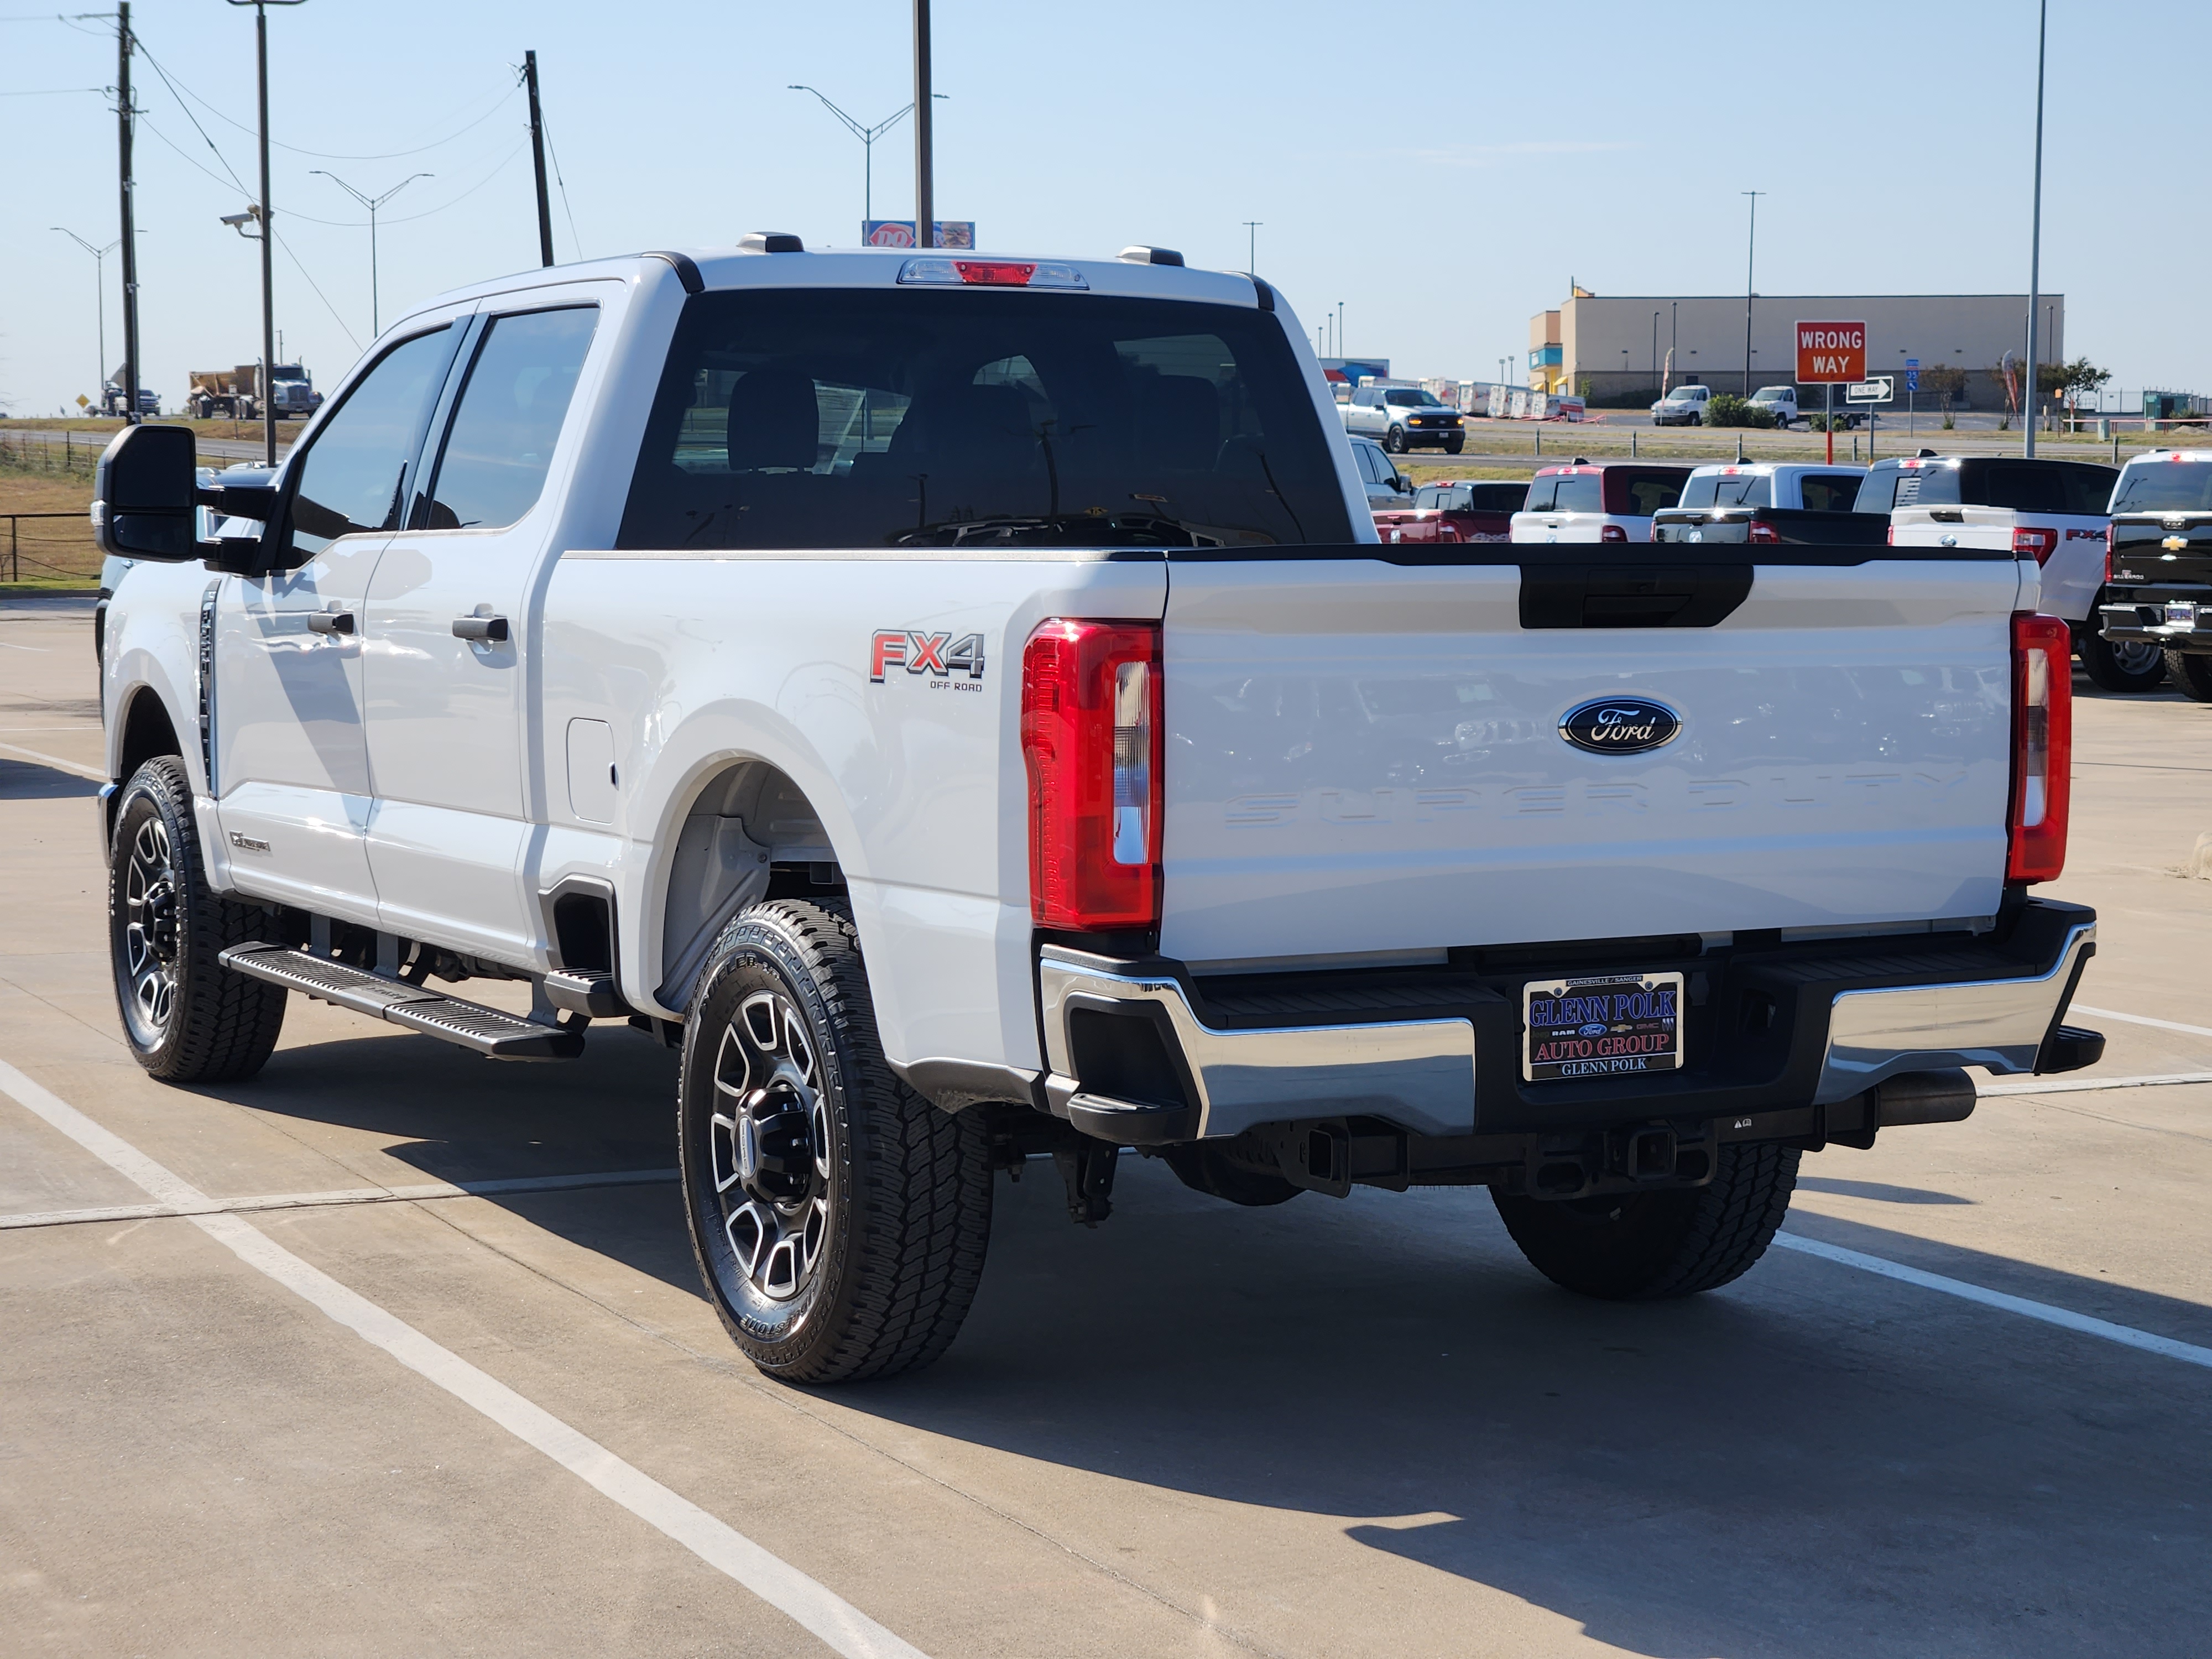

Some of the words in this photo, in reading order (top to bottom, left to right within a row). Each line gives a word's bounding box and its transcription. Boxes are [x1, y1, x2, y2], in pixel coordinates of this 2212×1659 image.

[878, 230, 907, 247] DQ
[1801, 331, 1863, 349] WRONG
[1813, 356, 1850, 374] WAY
[1907, 371, 1917, 379] 35
[870, 629, 985, 684] FX4
[930, 681, 950, 689] OFF
[954, 682, 983, 692] ROAD
[1590, 708, 1656, 741] Ford
[1529, 995, 1609, 1027] GLENN
[1613, 990, 1677, 1021] POLK
[1583, 1025, 1602, 1036] Ford
[1534, 1039, 1593, 1061] AUTO
[1597, 1034, 1670, 1056] GROUP
[1561, 1061, 1608, 1076] GLENN
[1610, 1057, 1647, 1072] POLK
